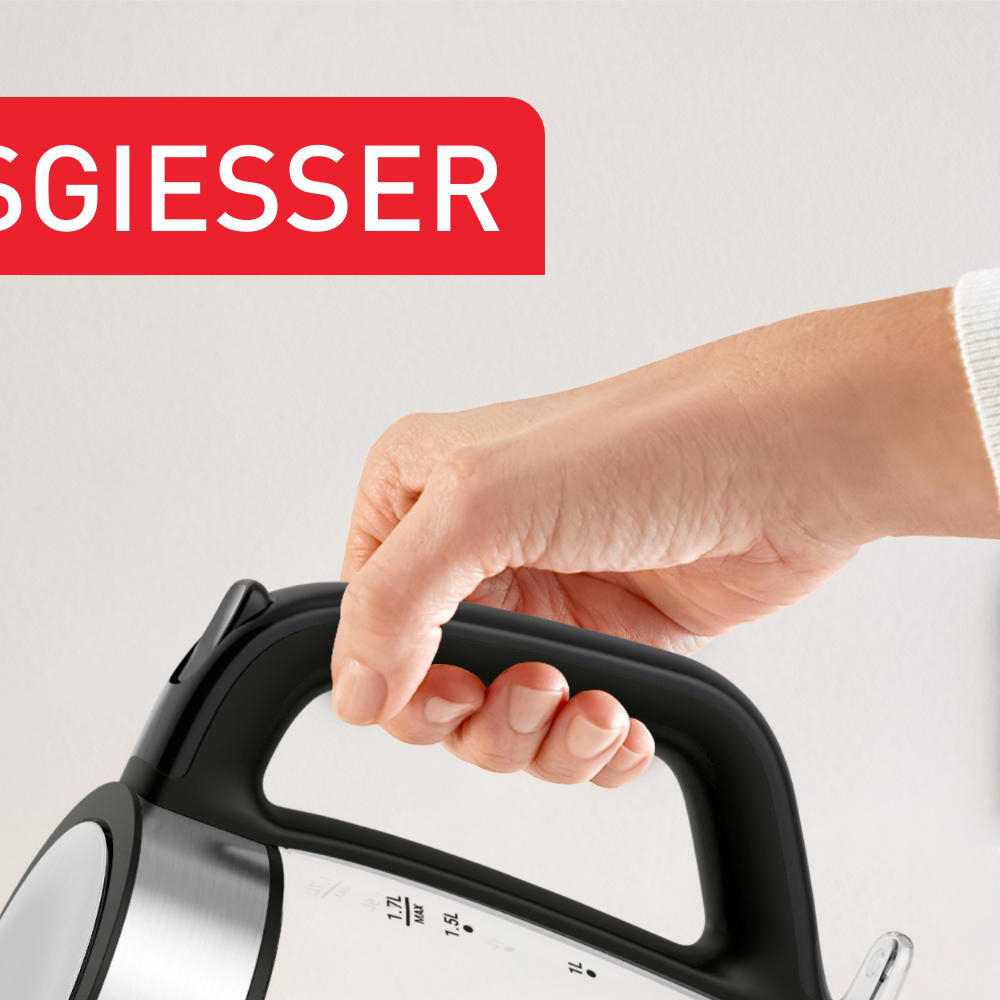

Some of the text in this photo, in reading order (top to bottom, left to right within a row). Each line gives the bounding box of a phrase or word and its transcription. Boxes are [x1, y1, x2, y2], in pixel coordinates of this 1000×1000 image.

[386, 896, 402, 920] 1.7L
[413, 903, 425, 925] MAX
[443, 912, 460, 937] 1.5L
[568, 962, 583, 974] 1L
